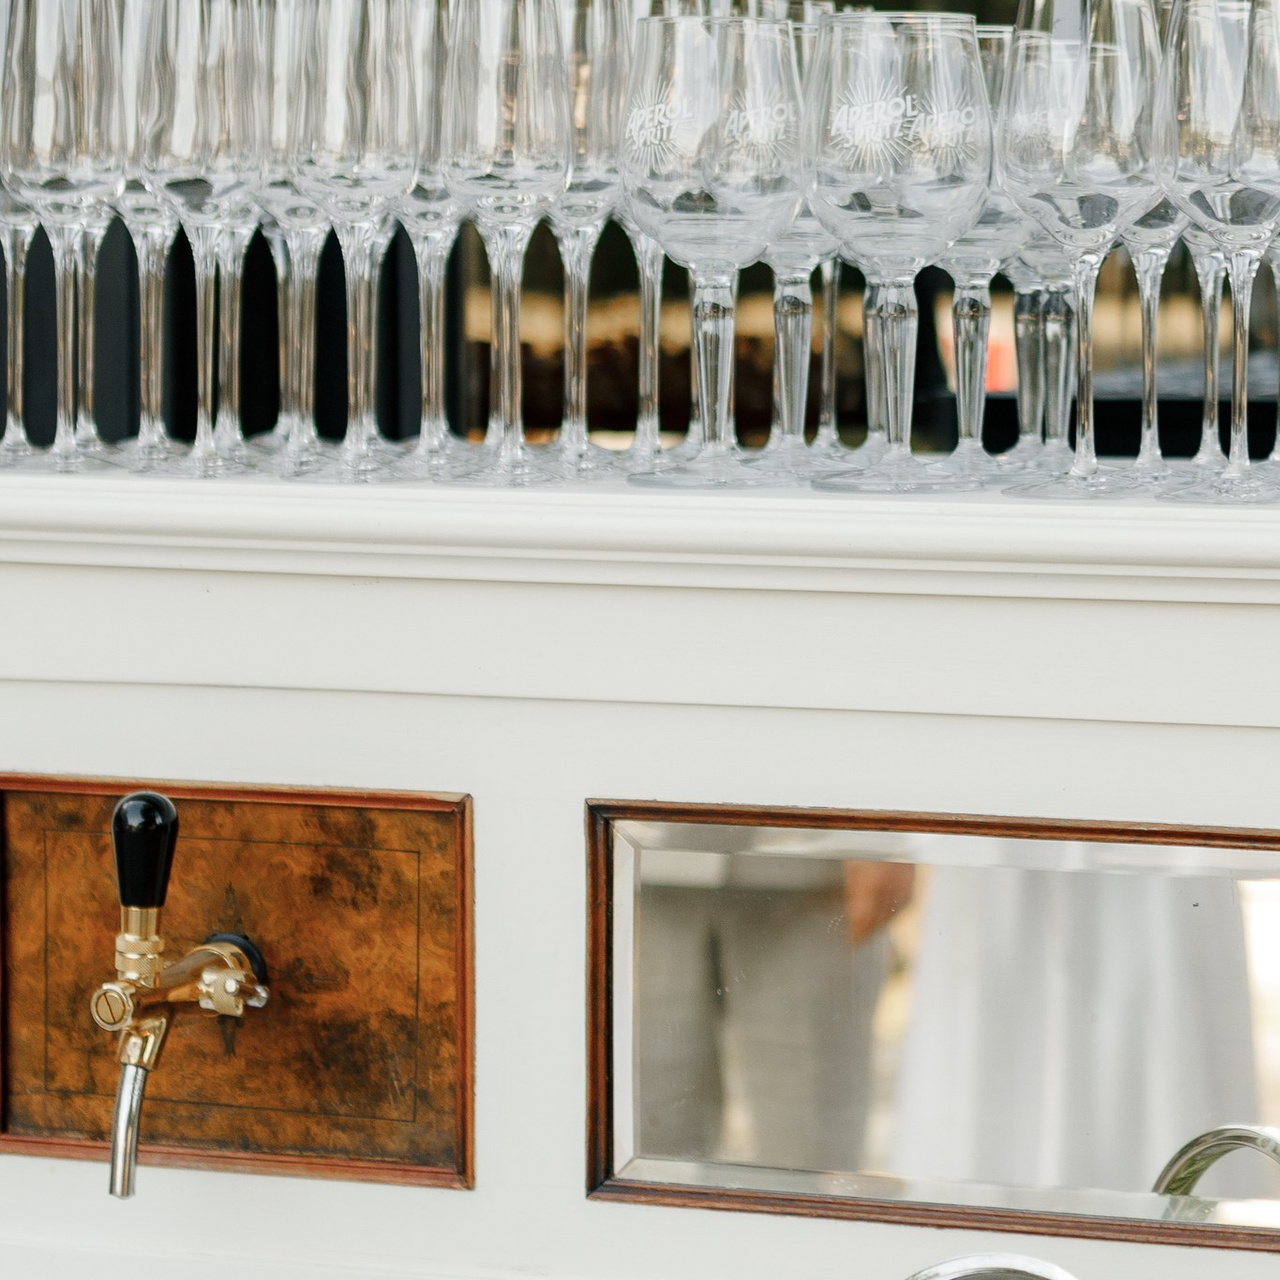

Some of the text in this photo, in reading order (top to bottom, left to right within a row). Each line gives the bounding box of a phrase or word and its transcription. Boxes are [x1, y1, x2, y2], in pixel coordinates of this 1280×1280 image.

[625, 97, 694, 139] APEROL
[724, 101, 797, 138] APEROL
[831, 95, 918, 136] APEROL
